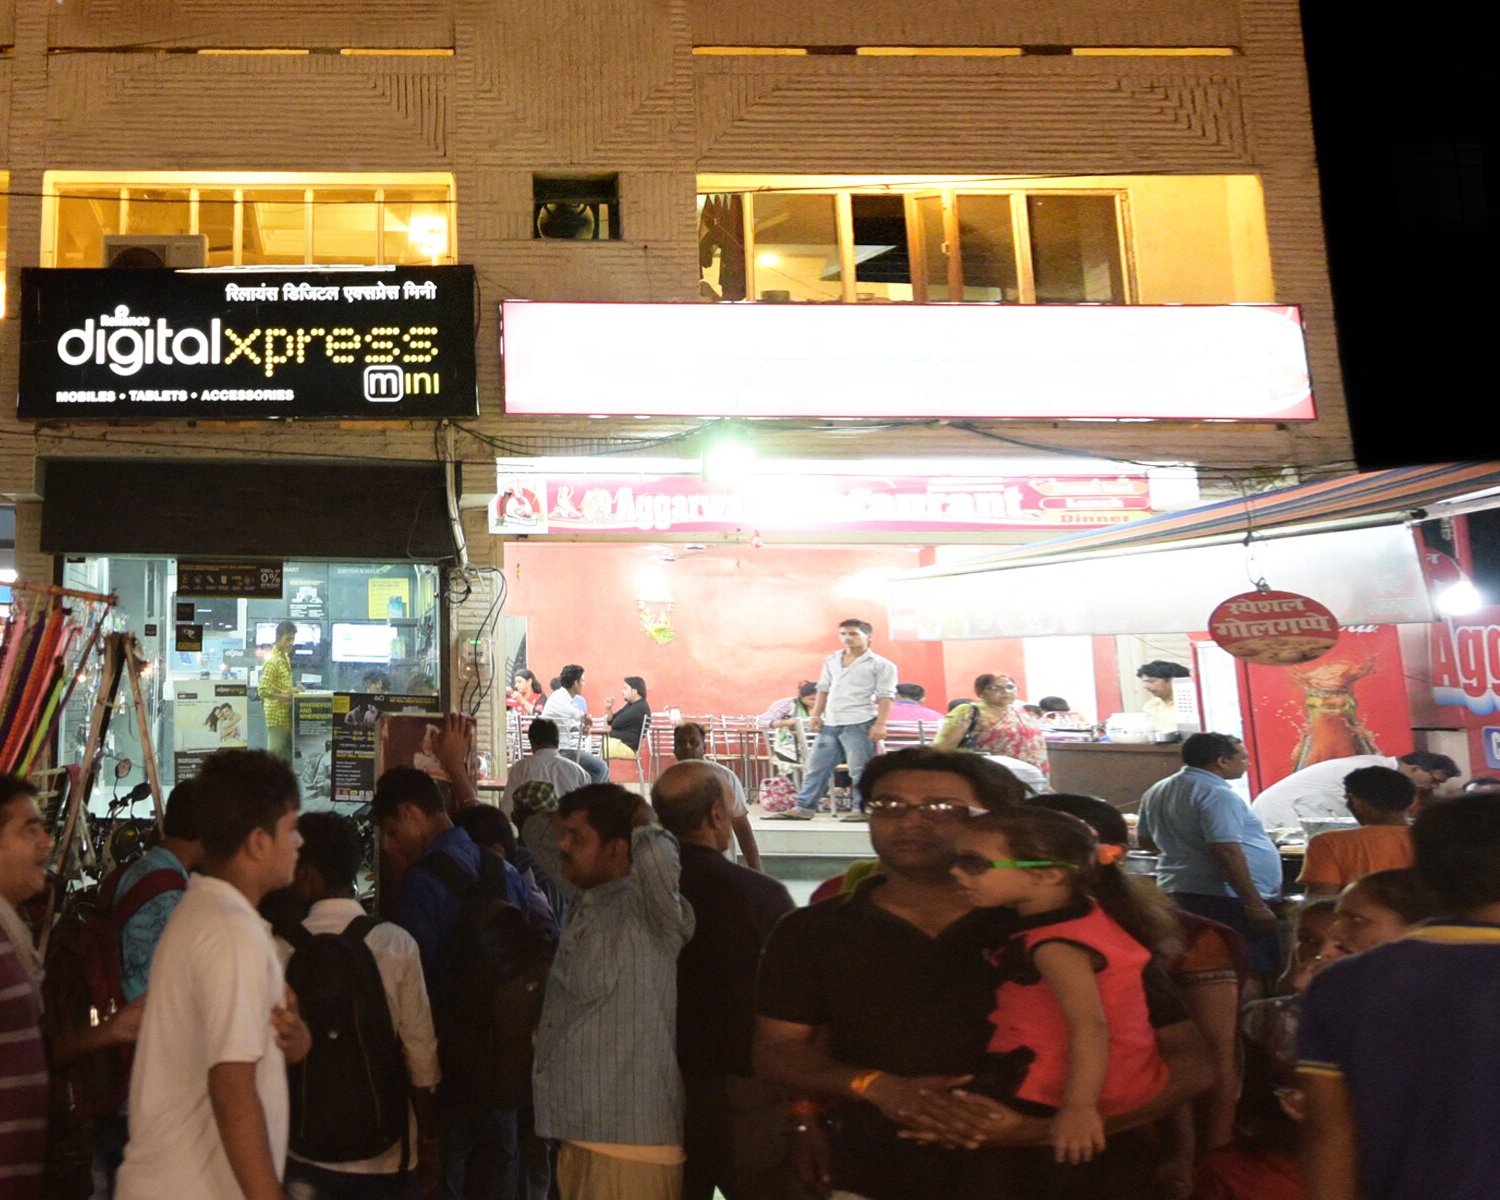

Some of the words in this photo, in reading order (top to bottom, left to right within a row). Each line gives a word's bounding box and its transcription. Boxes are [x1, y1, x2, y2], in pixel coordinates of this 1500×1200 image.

[225, 282, 279, 302] रिलायंस
[282, 282, 340, 301] डिजिटल
[343, 281, 400, 303] एक्सप्रेस
[403, 281, 437, 300] मिनी
[366, 369, 439, 398] mini
[56, 390, 116, 403] MOBILES
[128, 389, 188, 402] TABLETS
[201, 388, 295, 401] ACCESSORIES
[1060, 514, 1130, 523] Dinner
[260, 573, 281, 583] 0%
[1227, 596, 1306, 615] स्पेशल
[1213, 613, 1332, 640] गोलगप्पे
